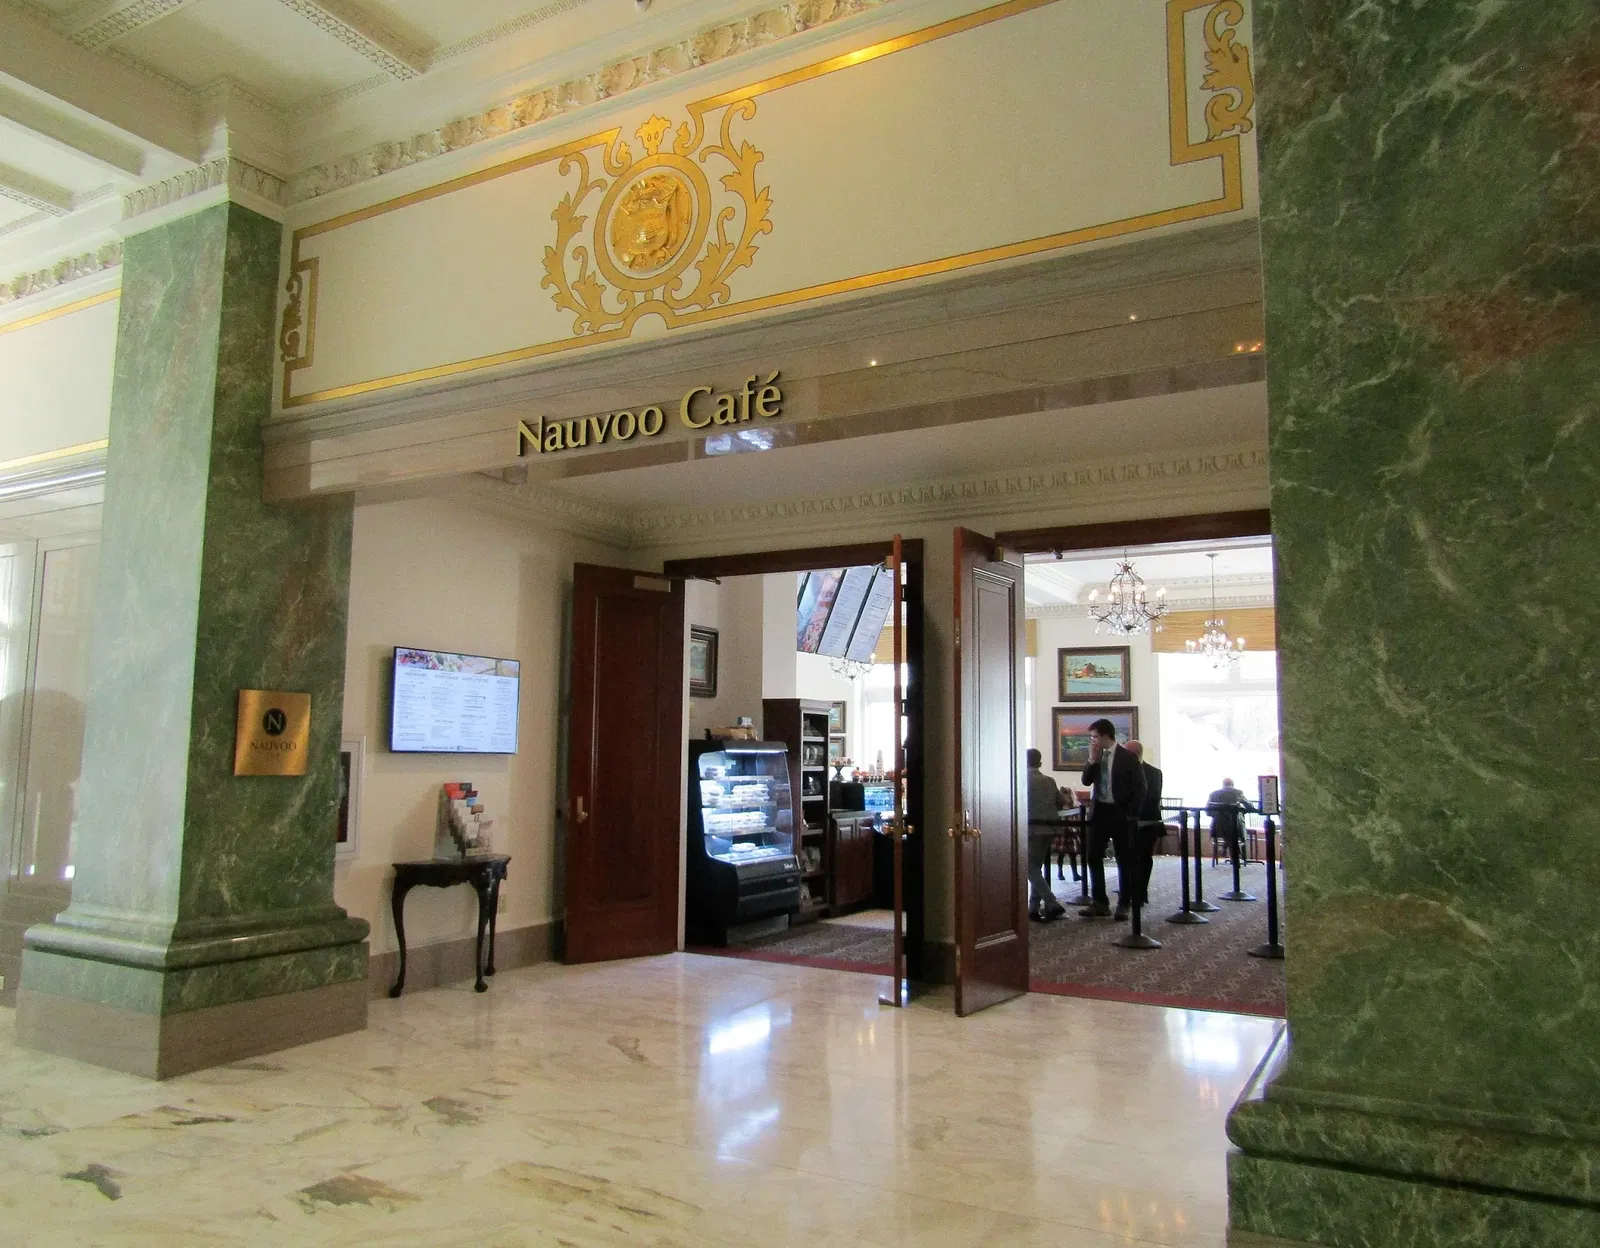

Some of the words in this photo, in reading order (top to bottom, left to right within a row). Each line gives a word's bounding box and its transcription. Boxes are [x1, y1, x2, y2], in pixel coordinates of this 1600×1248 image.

[516, 406, 664, 456] Nauvoo
[680, 370, 782, 429] Café
[267, 713, 282, 731] N
[250, 741, 297, 751] NAUVOO
